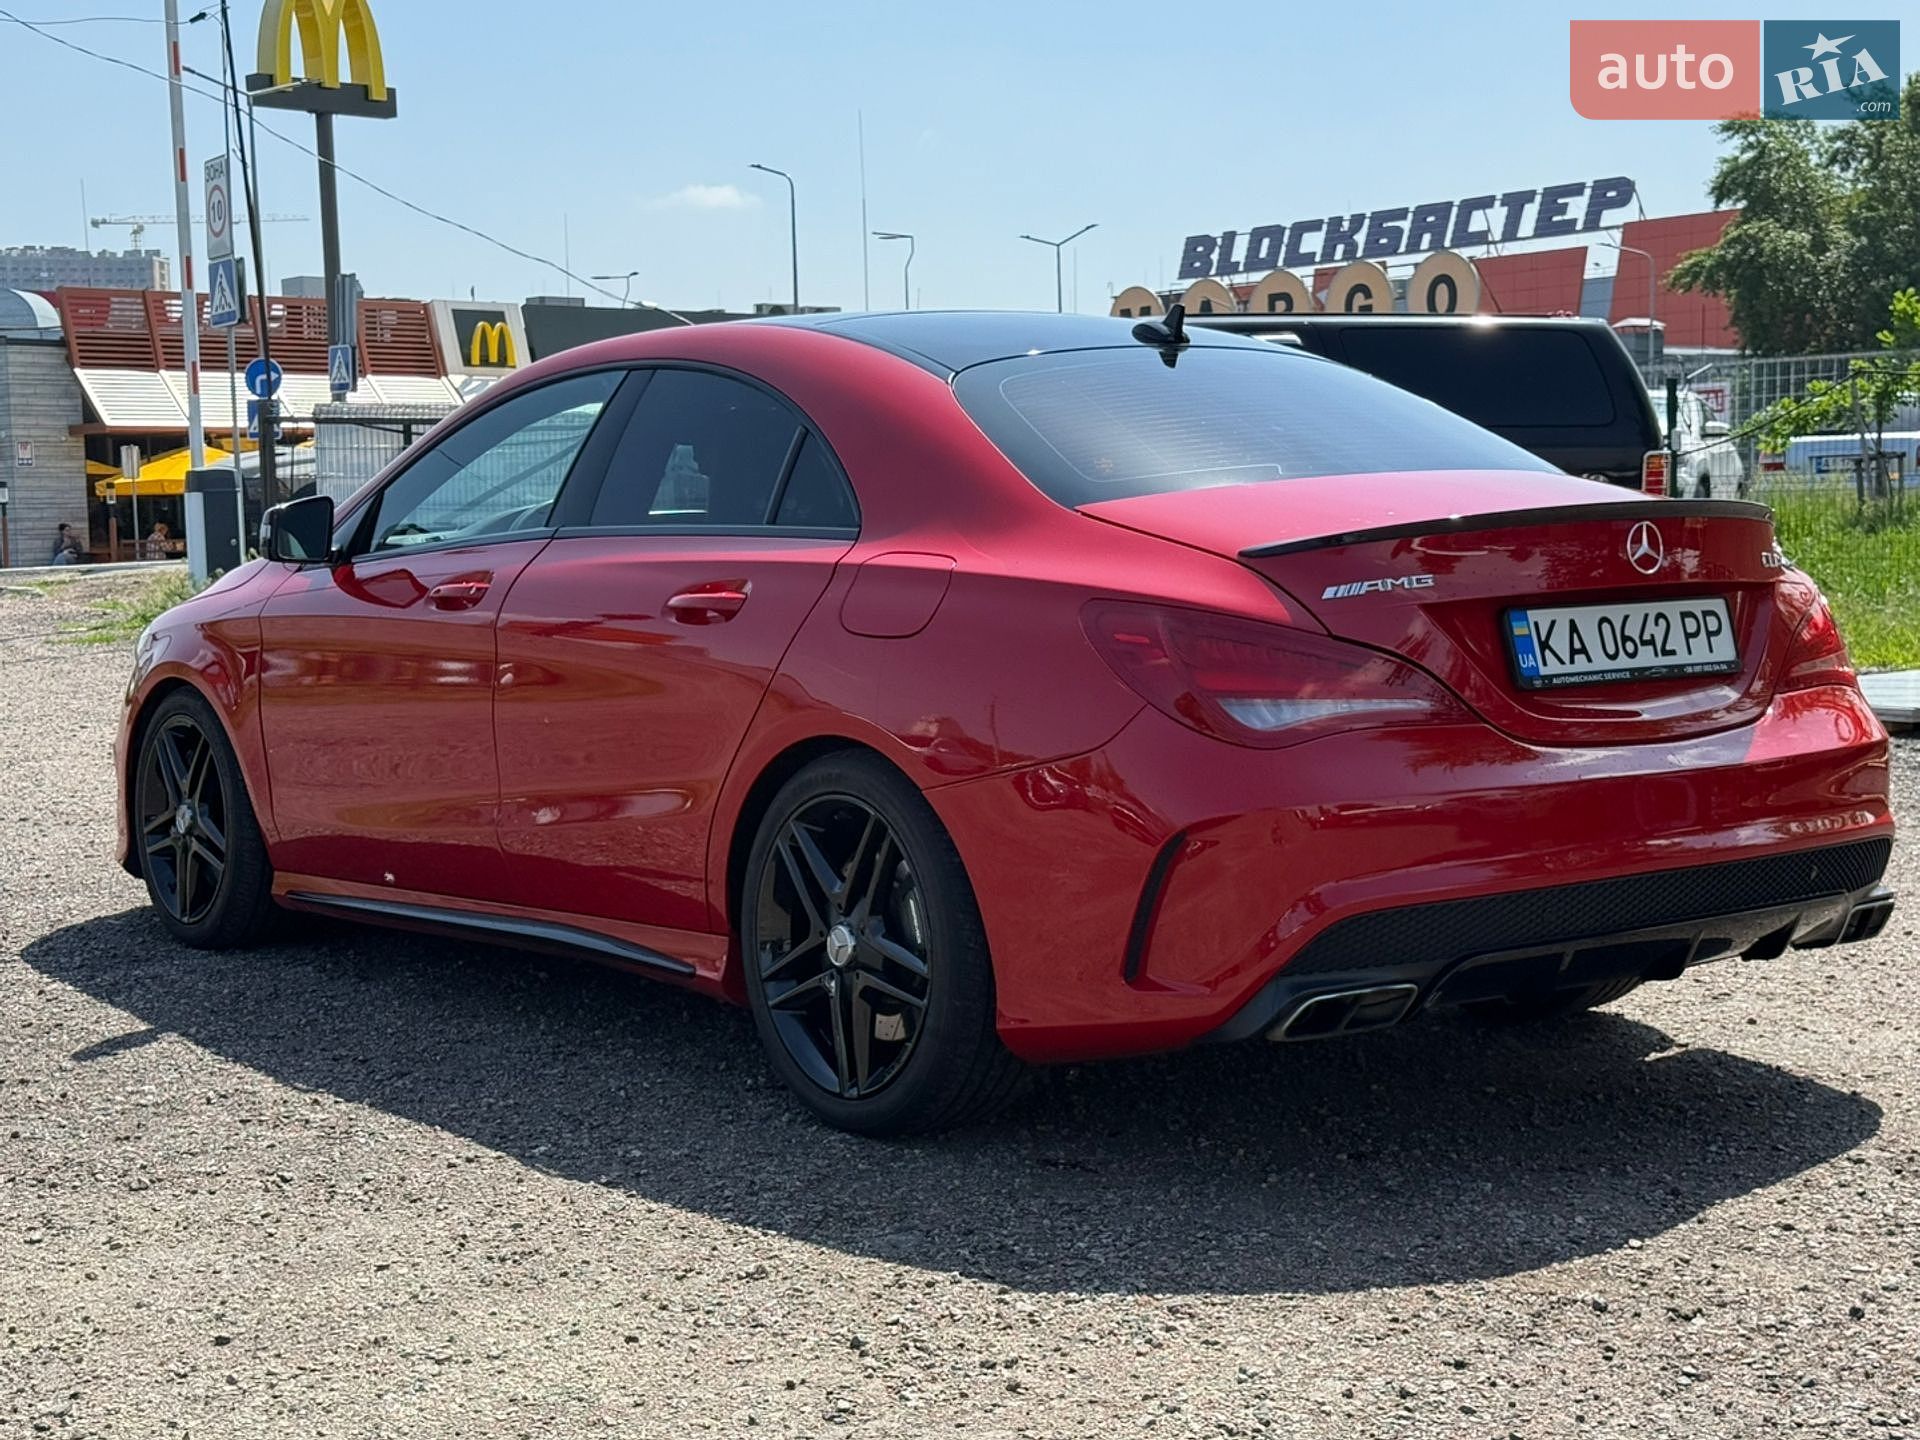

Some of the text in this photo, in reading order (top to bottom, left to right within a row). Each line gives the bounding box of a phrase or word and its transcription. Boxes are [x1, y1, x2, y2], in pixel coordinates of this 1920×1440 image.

[206, 160, 225, 183] ЗОНА
[211, 199, 223, 223] 10
[1533, 609, 1723, 667] KA 0642 PP
[1518, 653, 1537, 669] UA
[1604, 671, 1631, 680] SERVICE
